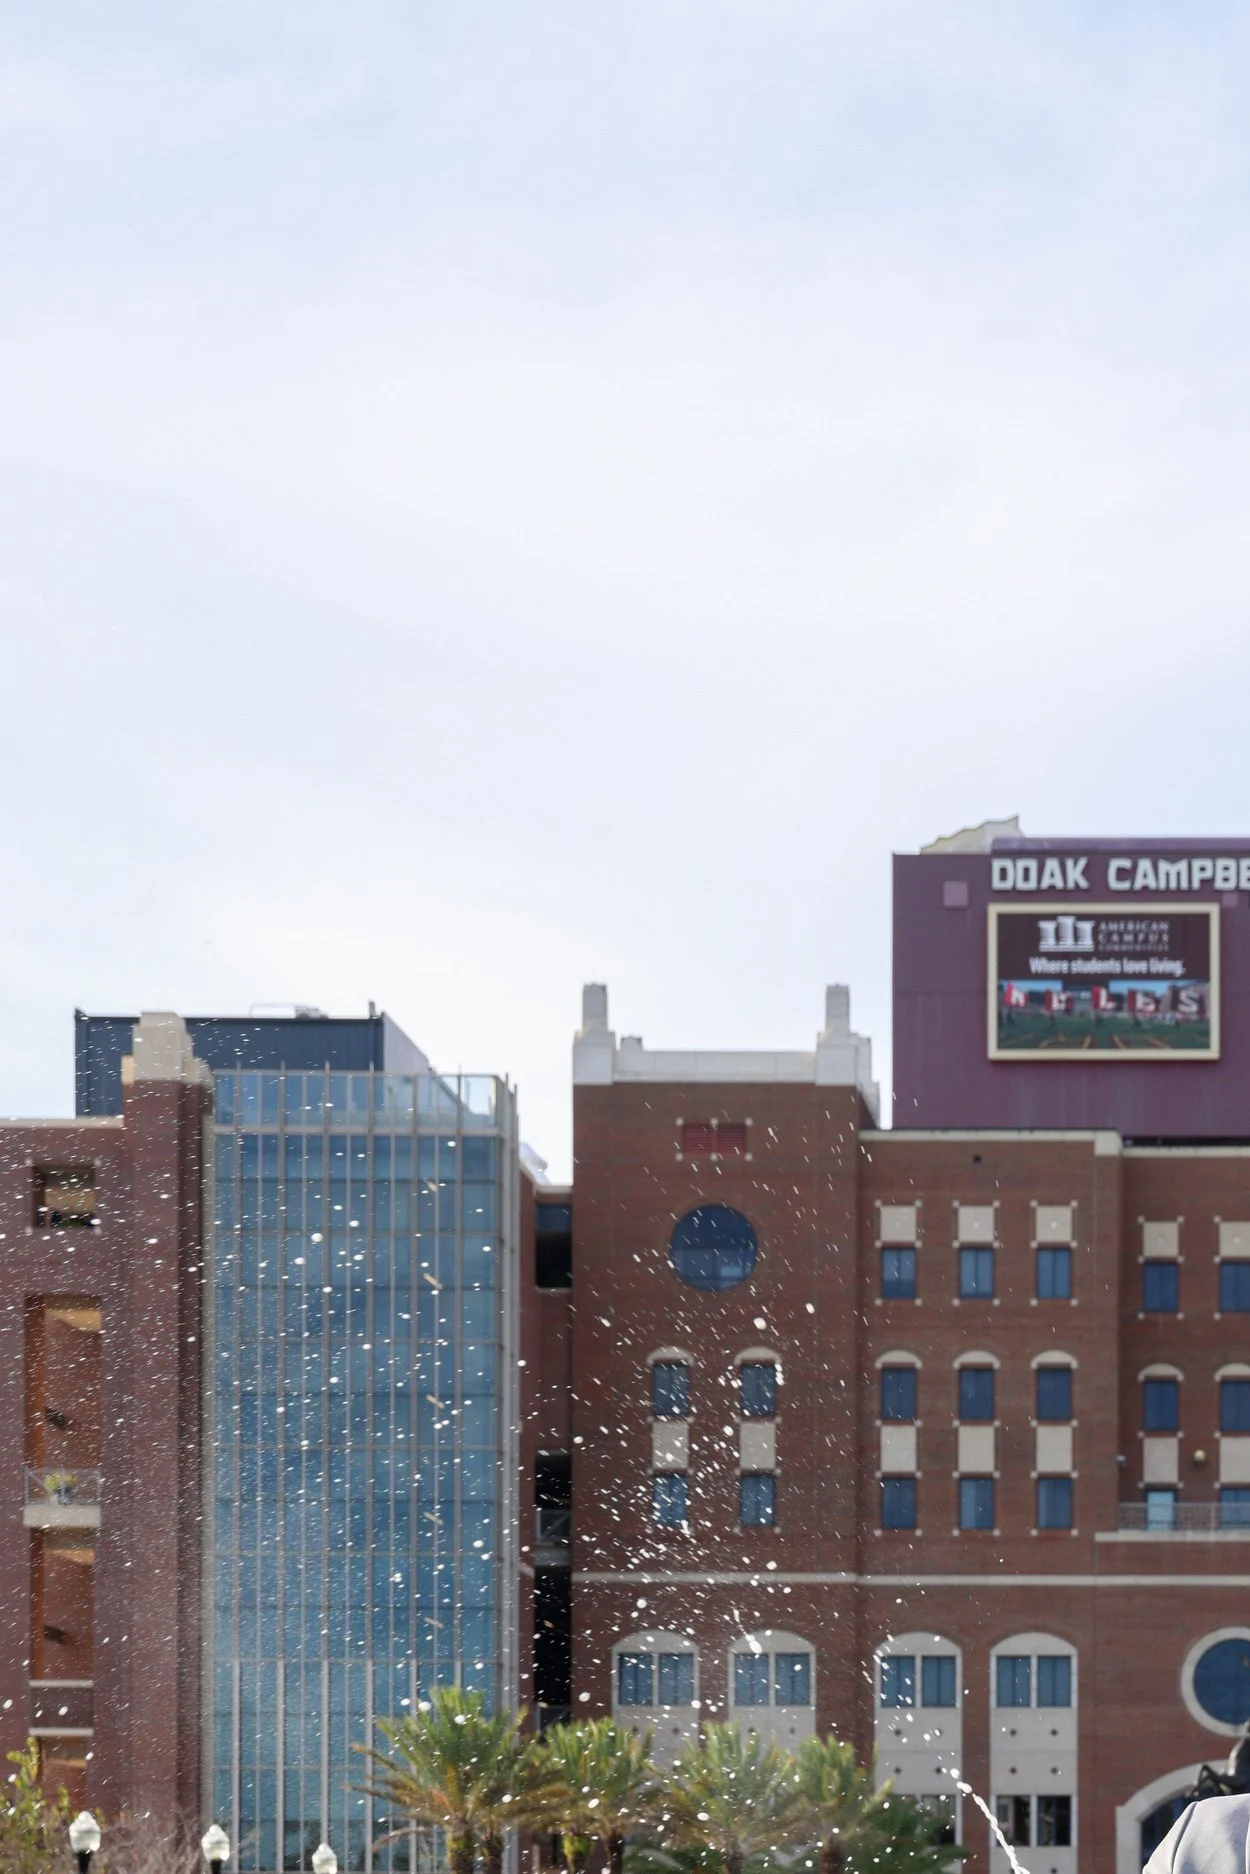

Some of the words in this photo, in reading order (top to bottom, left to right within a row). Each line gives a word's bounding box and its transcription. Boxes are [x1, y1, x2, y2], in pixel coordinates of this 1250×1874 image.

[991, 857, 1090, 891] DOAK
[1098, 920, 1169, 932] AMERICAN
[1098, 932, 1169, 944] CAMPUS
[1029, 957, 1069, 974] Where
[1071, 957, 1121, 974] students
[1123, 957, 1148, 974] love
[1149, 957, 1186, 976] living.
